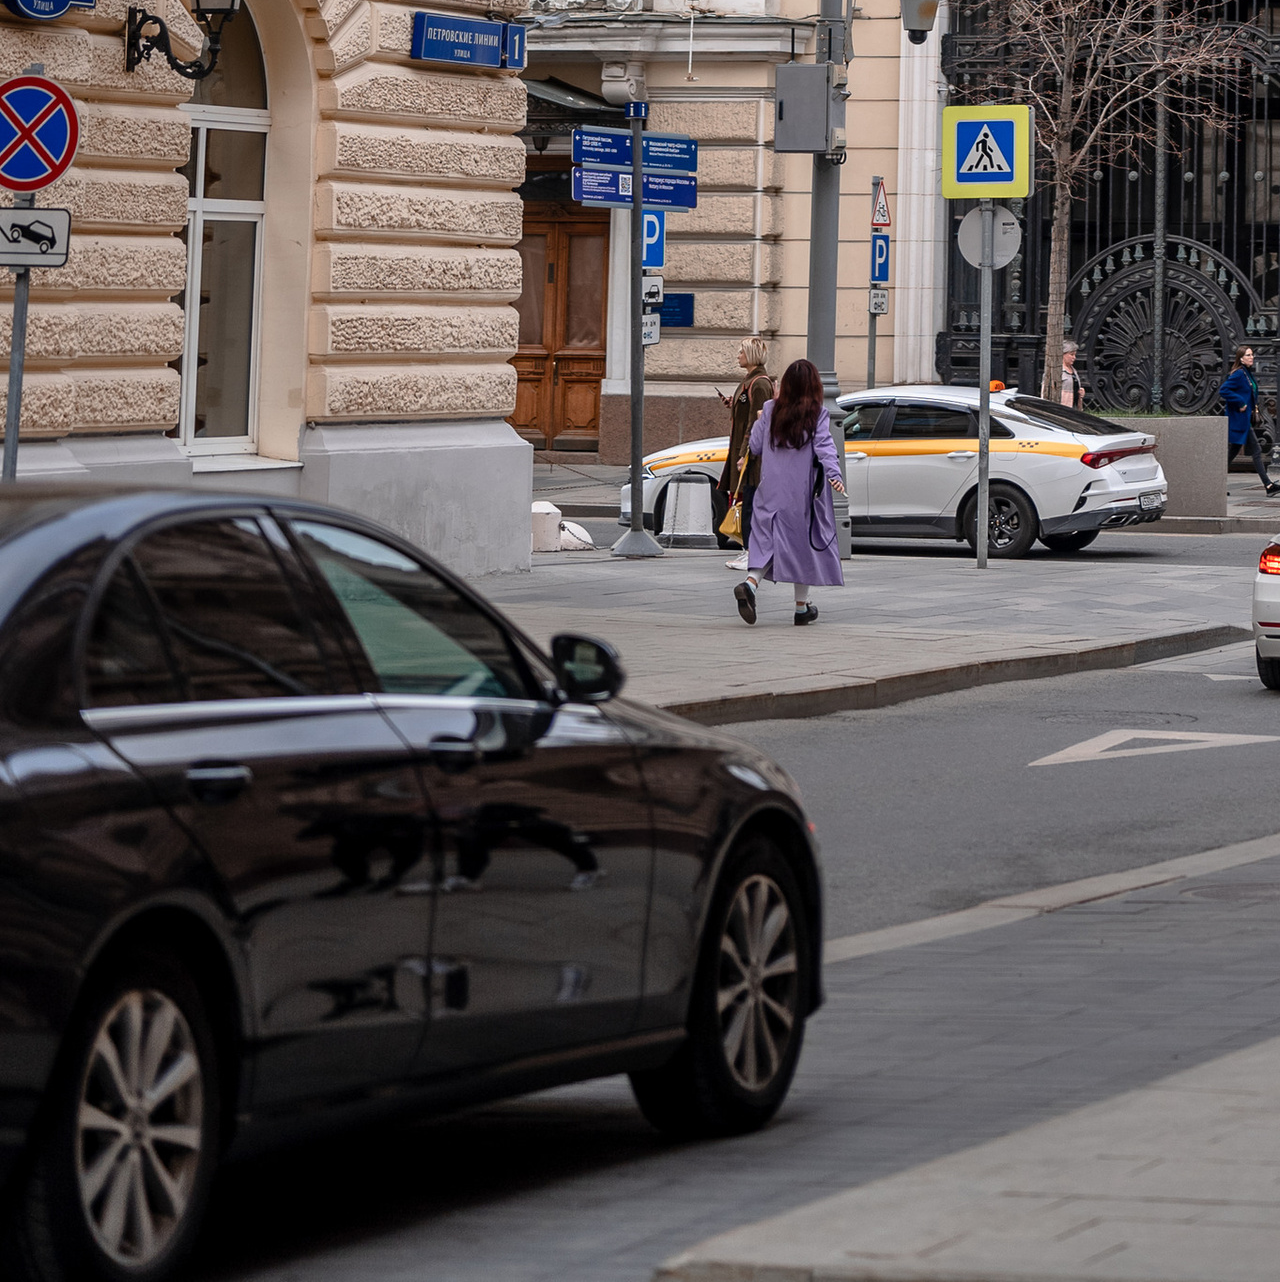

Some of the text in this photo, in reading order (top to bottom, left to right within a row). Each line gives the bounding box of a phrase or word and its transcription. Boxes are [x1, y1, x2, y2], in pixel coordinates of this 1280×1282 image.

[33, 0, 54, 11] УЛИЦА
[427, 27, 499, 47] ПЕТРОВСКИЕ ЛИНИИ
[454, 49, 470, 58] УЛИЦА
[513, 34, 520, 60] 1
